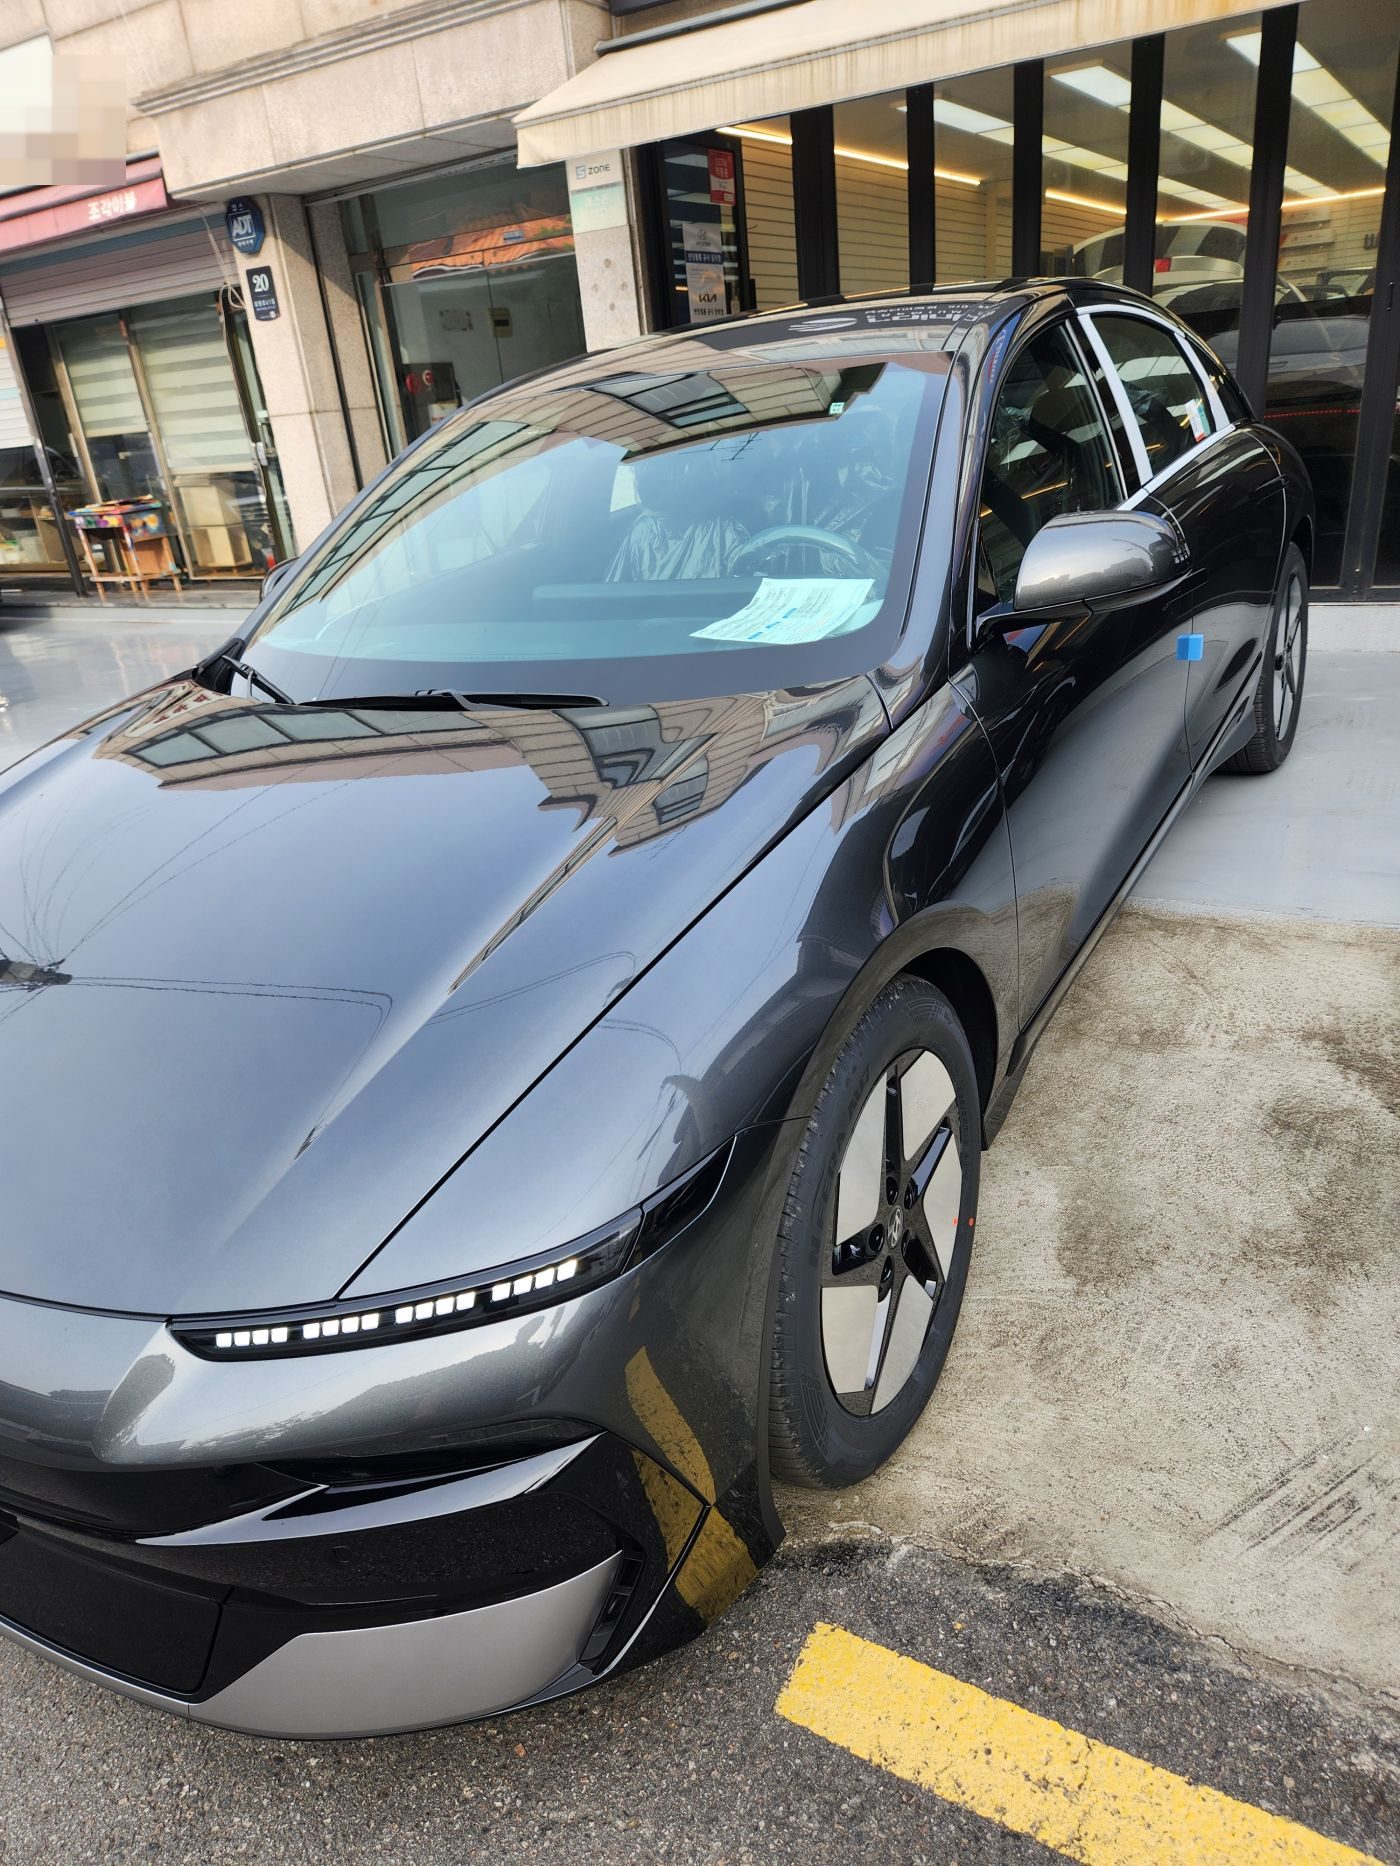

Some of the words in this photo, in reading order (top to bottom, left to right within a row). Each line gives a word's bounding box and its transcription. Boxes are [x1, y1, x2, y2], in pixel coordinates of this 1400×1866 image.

[588, 163, 611, 175] zone
[232, 214, 253, 237] ADT
[251, 273, 270, 293] 20
